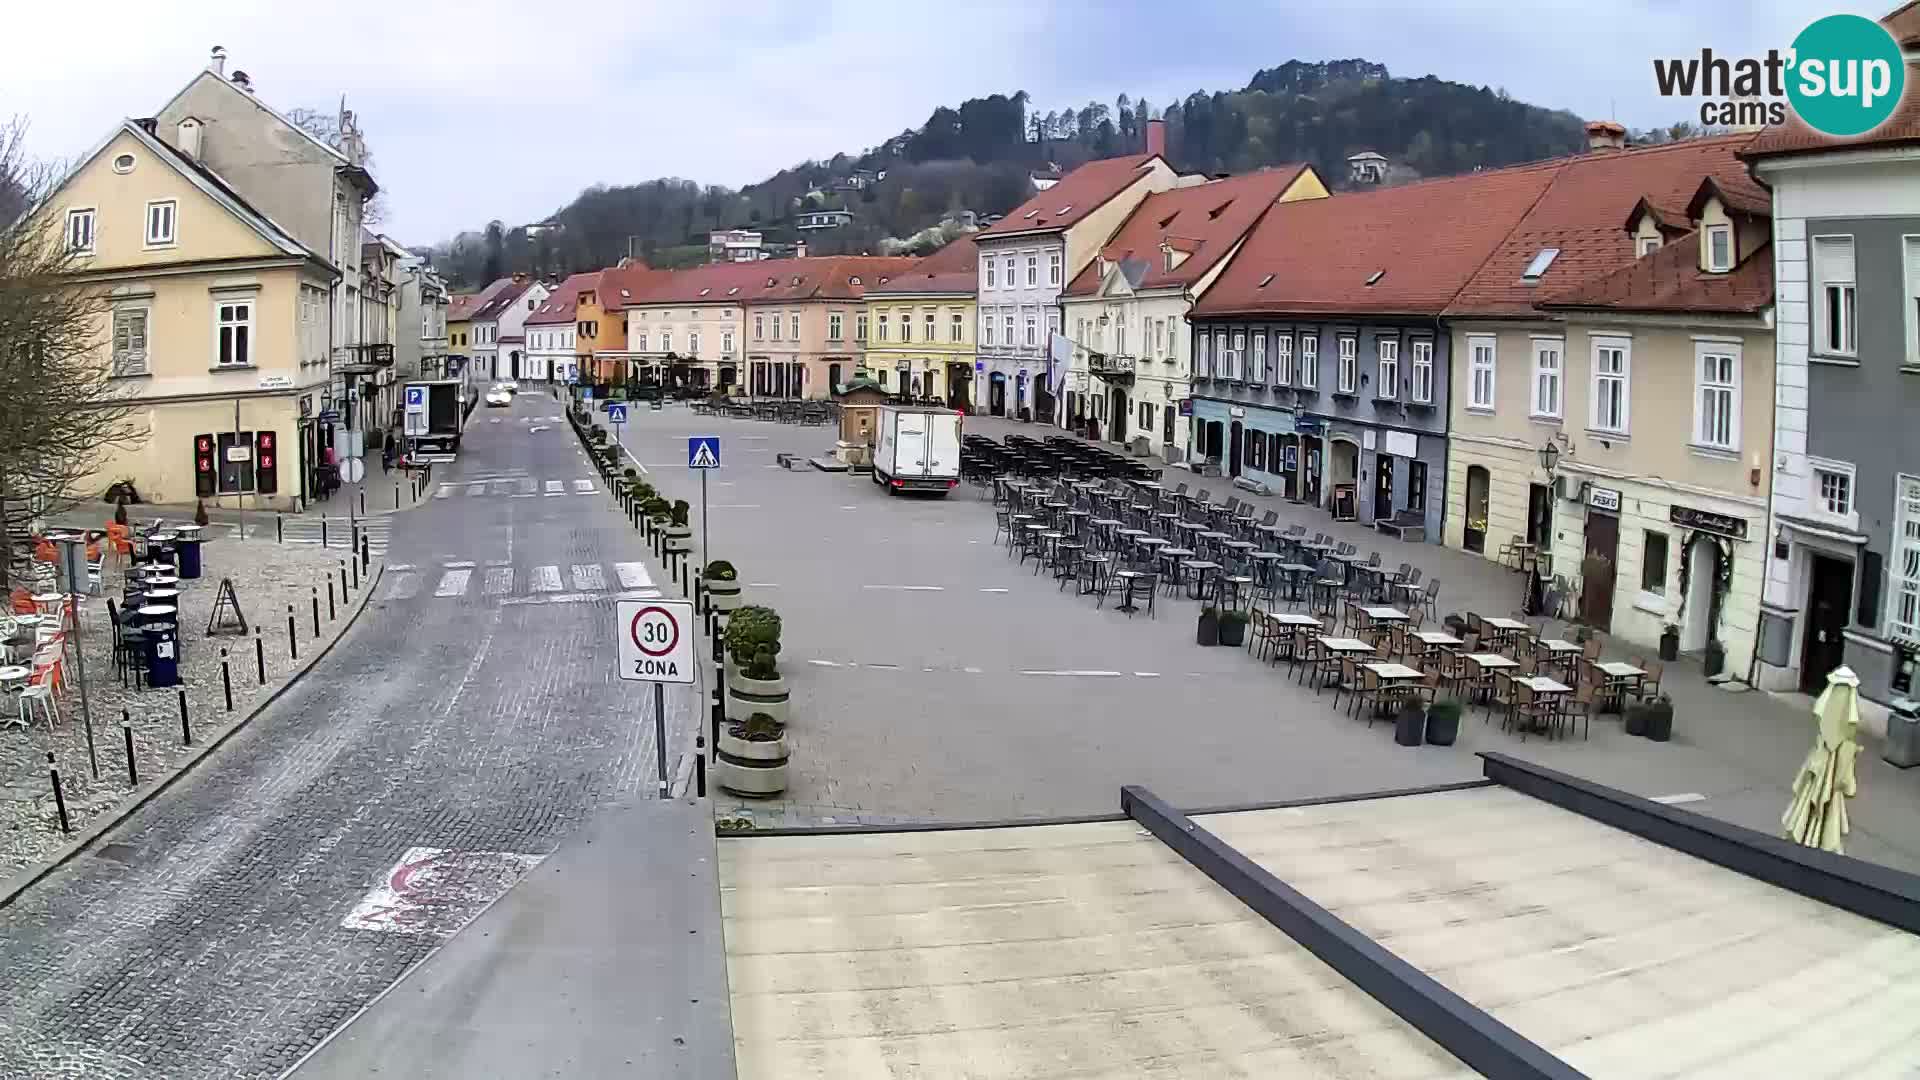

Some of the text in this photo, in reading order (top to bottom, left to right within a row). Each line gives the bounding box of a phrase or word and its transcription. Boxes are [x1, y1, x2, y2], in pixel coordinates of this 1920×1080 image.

[411, 391, 419, 402] P
[644, 622, 667, 643] 30
[634, 659, 678, 676] ZONA
